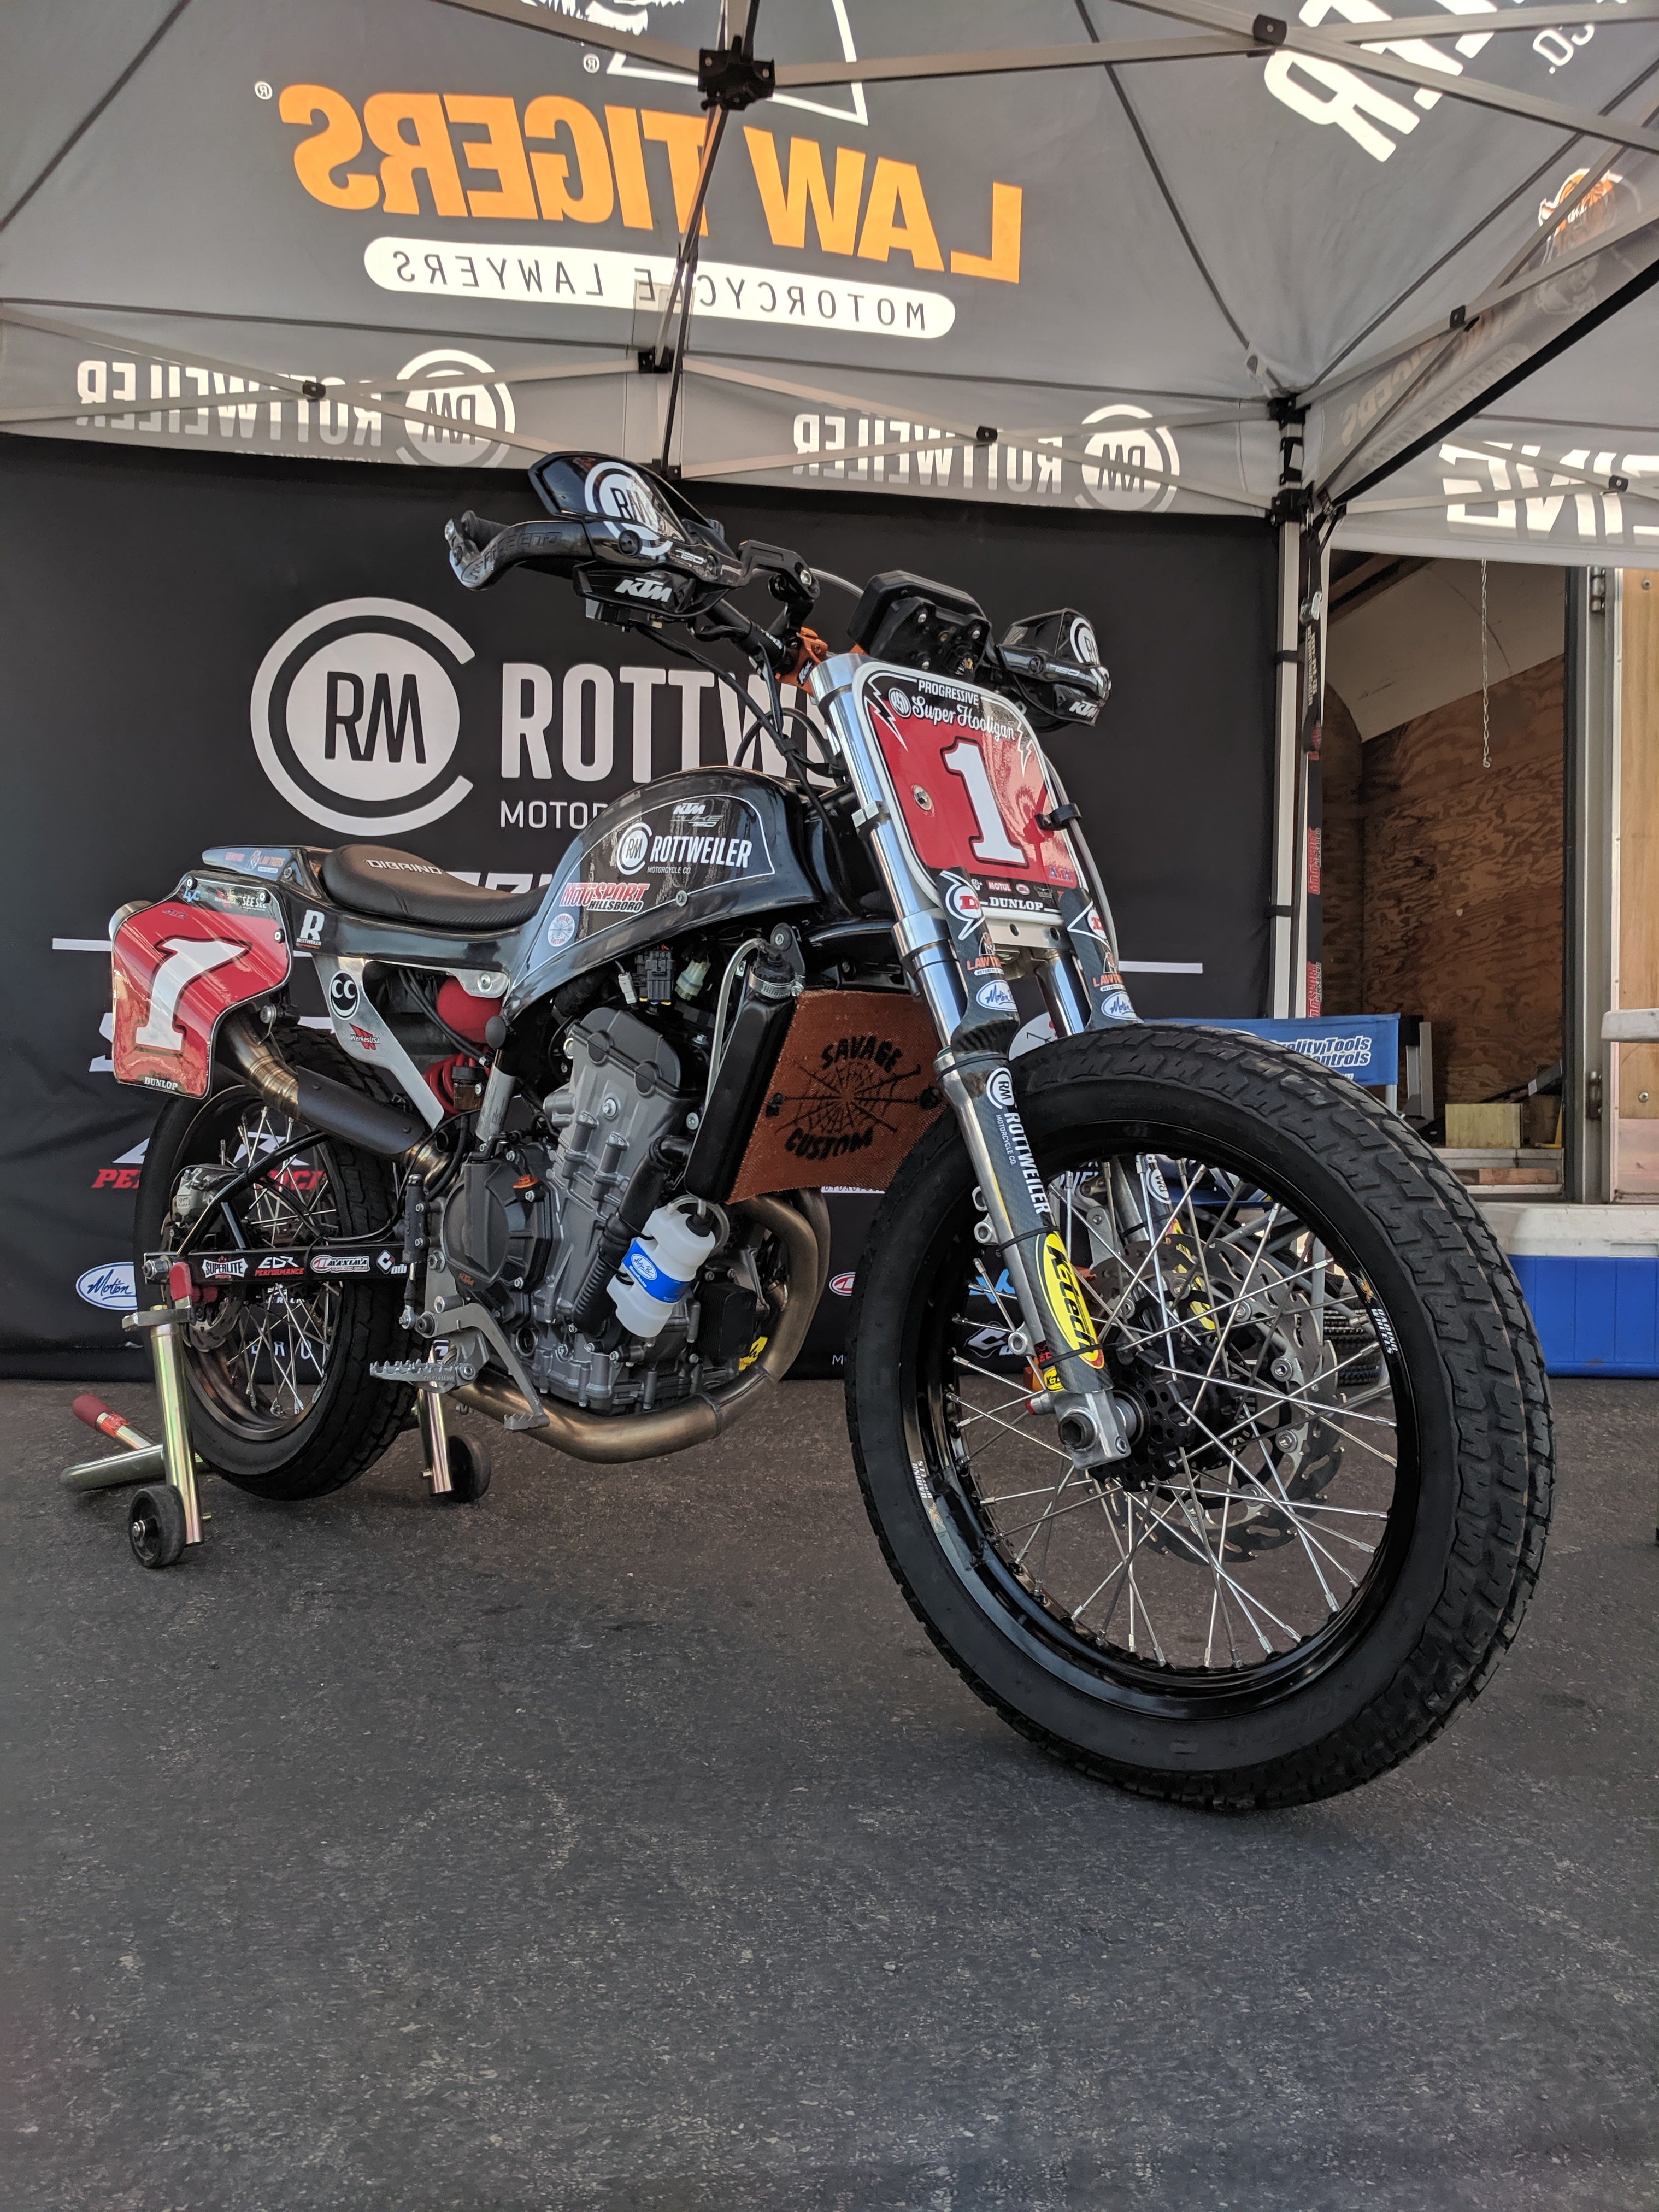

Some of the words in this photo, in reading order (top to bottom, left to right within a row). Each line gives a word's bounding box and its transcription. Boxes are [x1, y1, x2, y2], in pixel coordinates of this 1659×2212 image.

[614, 577, 673, 602] KTM
[918, 679, 980, 706] PROGRESSIVE
[911, 696, 956, 726] Super
[956, 704, 1016, 742] Hooligan
[672, 802, 707, 815] KTM
[943, 738, 1028, 867] 1
[649, 836, 752, 868] ROTTWEILER
[646, 866, 681, 874] MOTORCYCLE
[987, 881, 1011, 892] MOTUL
[586, 901, 644, 913] HILLSBORO
[989, 896, 1044, 912] DUNLOP
[300, 909, 325, 942] R
[966, 956, 990, 971] LAW
[350, 1033, 381, 1044] WerkesUSA
[1325, 1035, 1372, 1053] Tools
[821, 1036, 903, 1073] SAVAGE
[144, 1076, 178, 1091] DUNLOP
[995, 1113, 1014, 1155] MOTORCYCLE
[784, 1127, 874, 1161] CUSTOM
[1004, 1111, 1052, 1215] ROTTWEILER
[205, 1261, 244, 1275] SUPERLITE
[254, 1267, 305, 1277] PERFORMANCE
